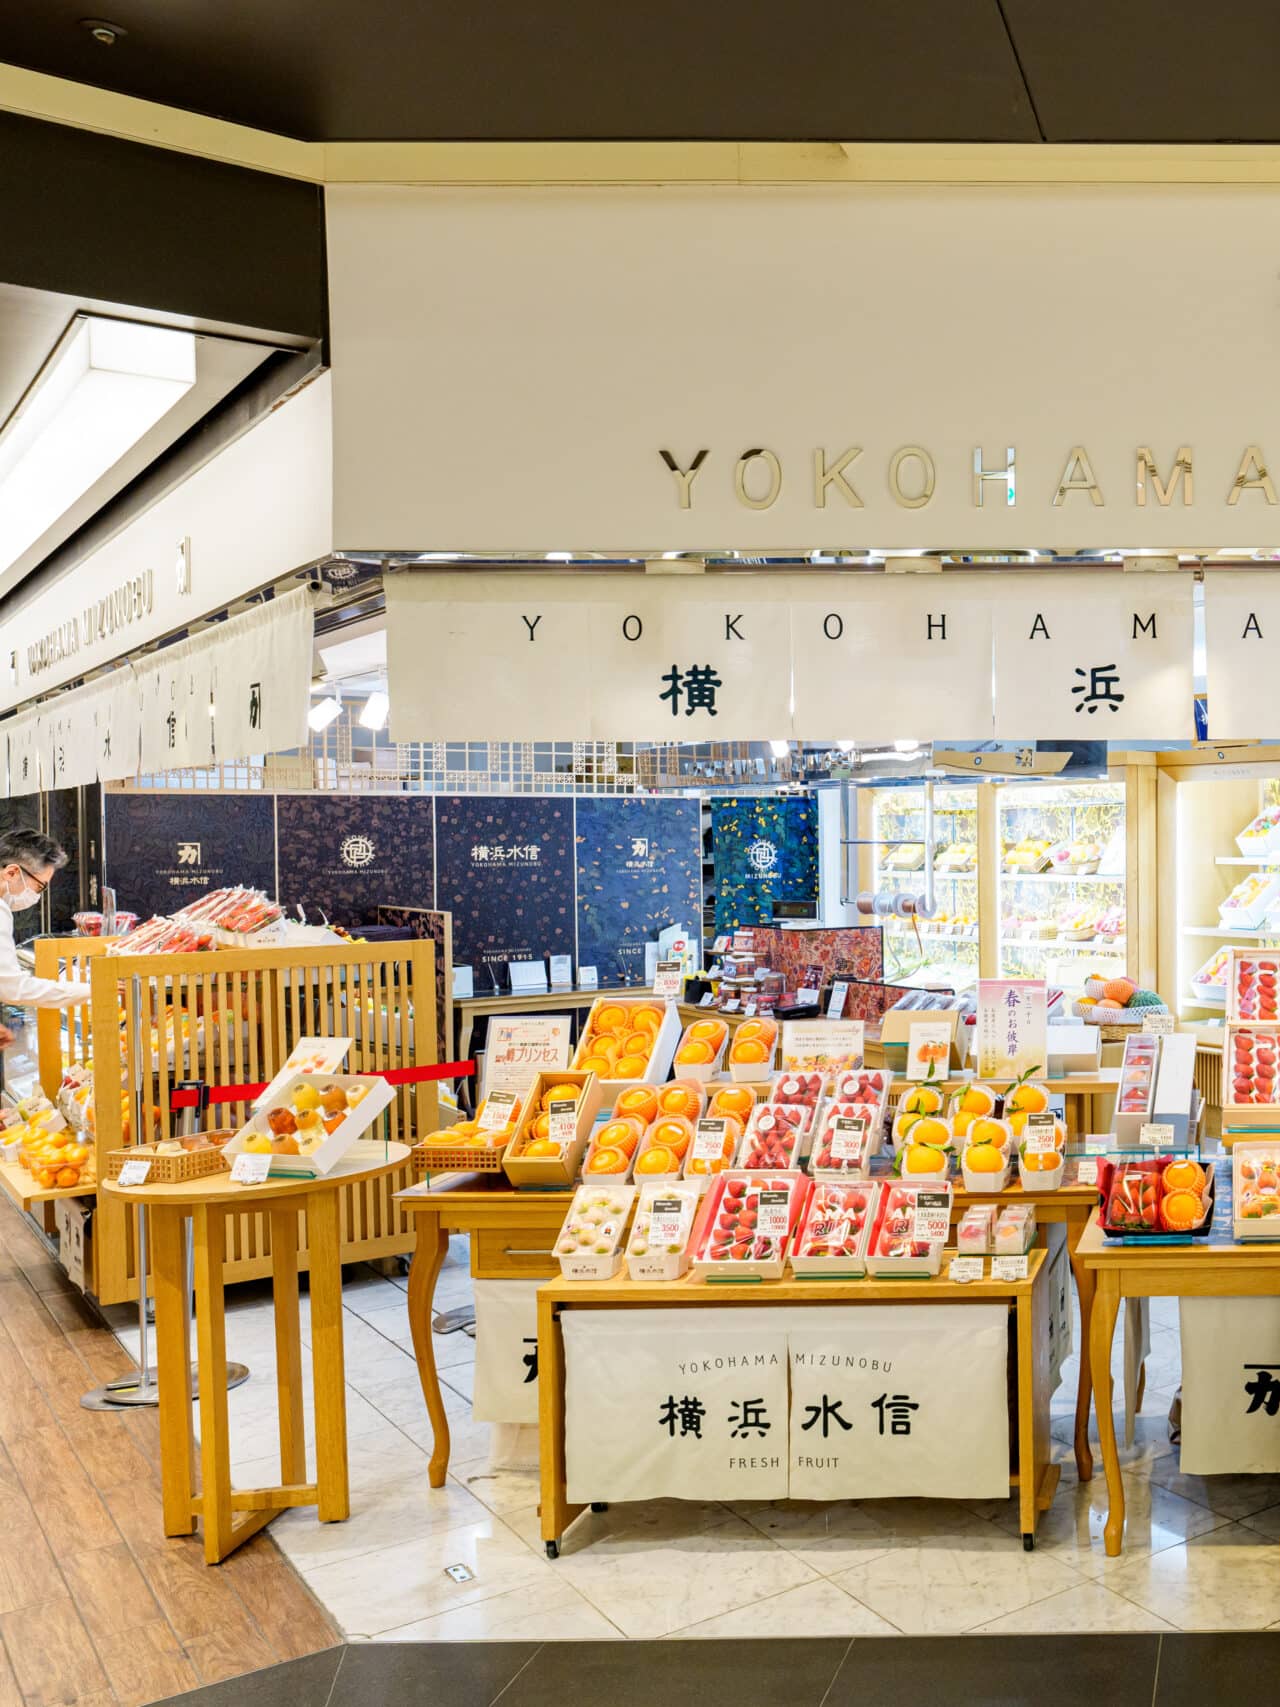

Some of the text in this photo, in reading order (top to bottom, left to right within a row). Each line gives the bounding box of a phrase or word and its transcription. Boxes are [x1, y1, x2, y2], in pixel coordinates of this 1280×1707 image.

[658, 447, 1278, 510] YOKOHAMA
[471, 845, 541, 861] 横浜水信
[481, 953, 533, 963] SINCE 1915
[1004, 989, 1021, 1057] 春のお彼岸
[927, 1221, 947, 1230] 5000
[680, 1353, 892, 1375] YOKOHAMA MIZUNOBU
[658, 1393, 920, 1440] 横浜水信
[729, 1456, 839, 1468] FRESH FRUIT
